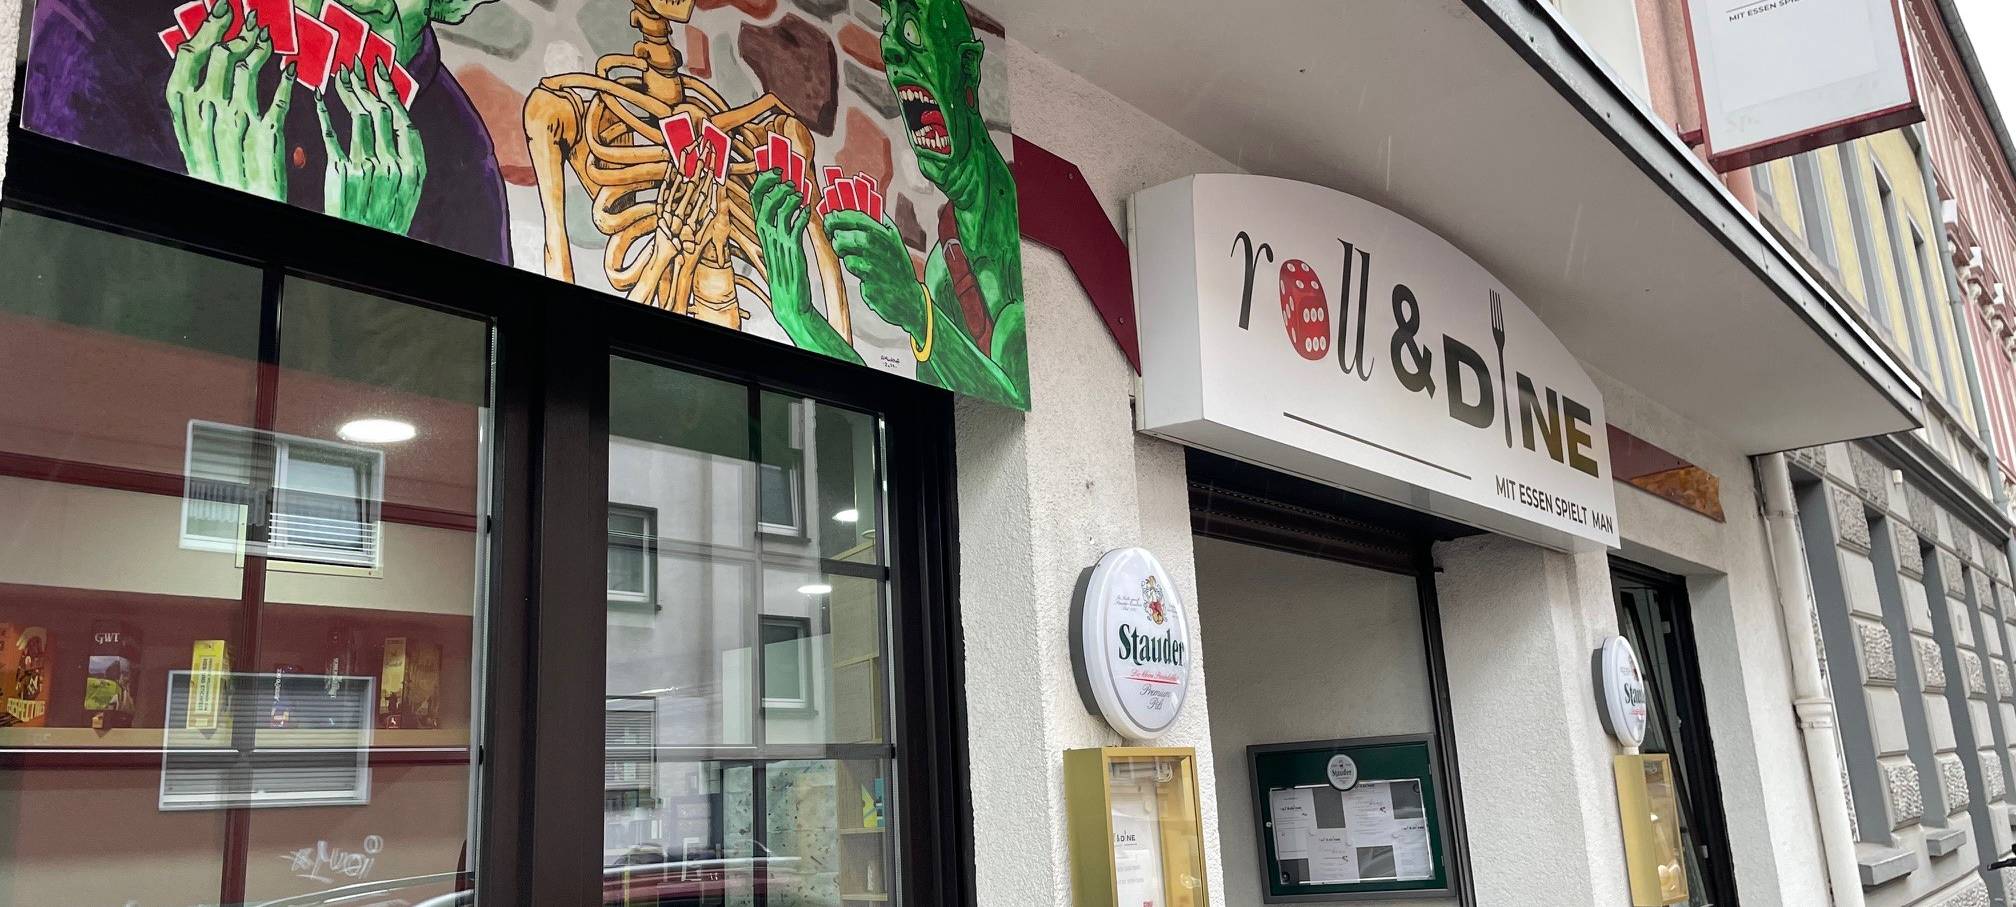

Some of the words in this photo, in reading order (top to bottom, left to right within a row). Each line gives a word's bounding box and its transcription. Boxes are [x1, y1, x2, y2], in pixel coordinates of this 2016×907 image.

[1729, 12, 1745, 21] MIT
[1748, 3, 1776, 16] ESSEN
[1230, 230, 1375, 382] roll
[1390, 283, 1436, 399] &
[1495, 474, 1516, 501] MIT
[1518, 483, 1554, 514] ESSEN
[1554, 496, 1588, 526] SPIELT
[1591, 510, 1614, 535] MAN
[1118, 623, 1185, 667] Stauder
